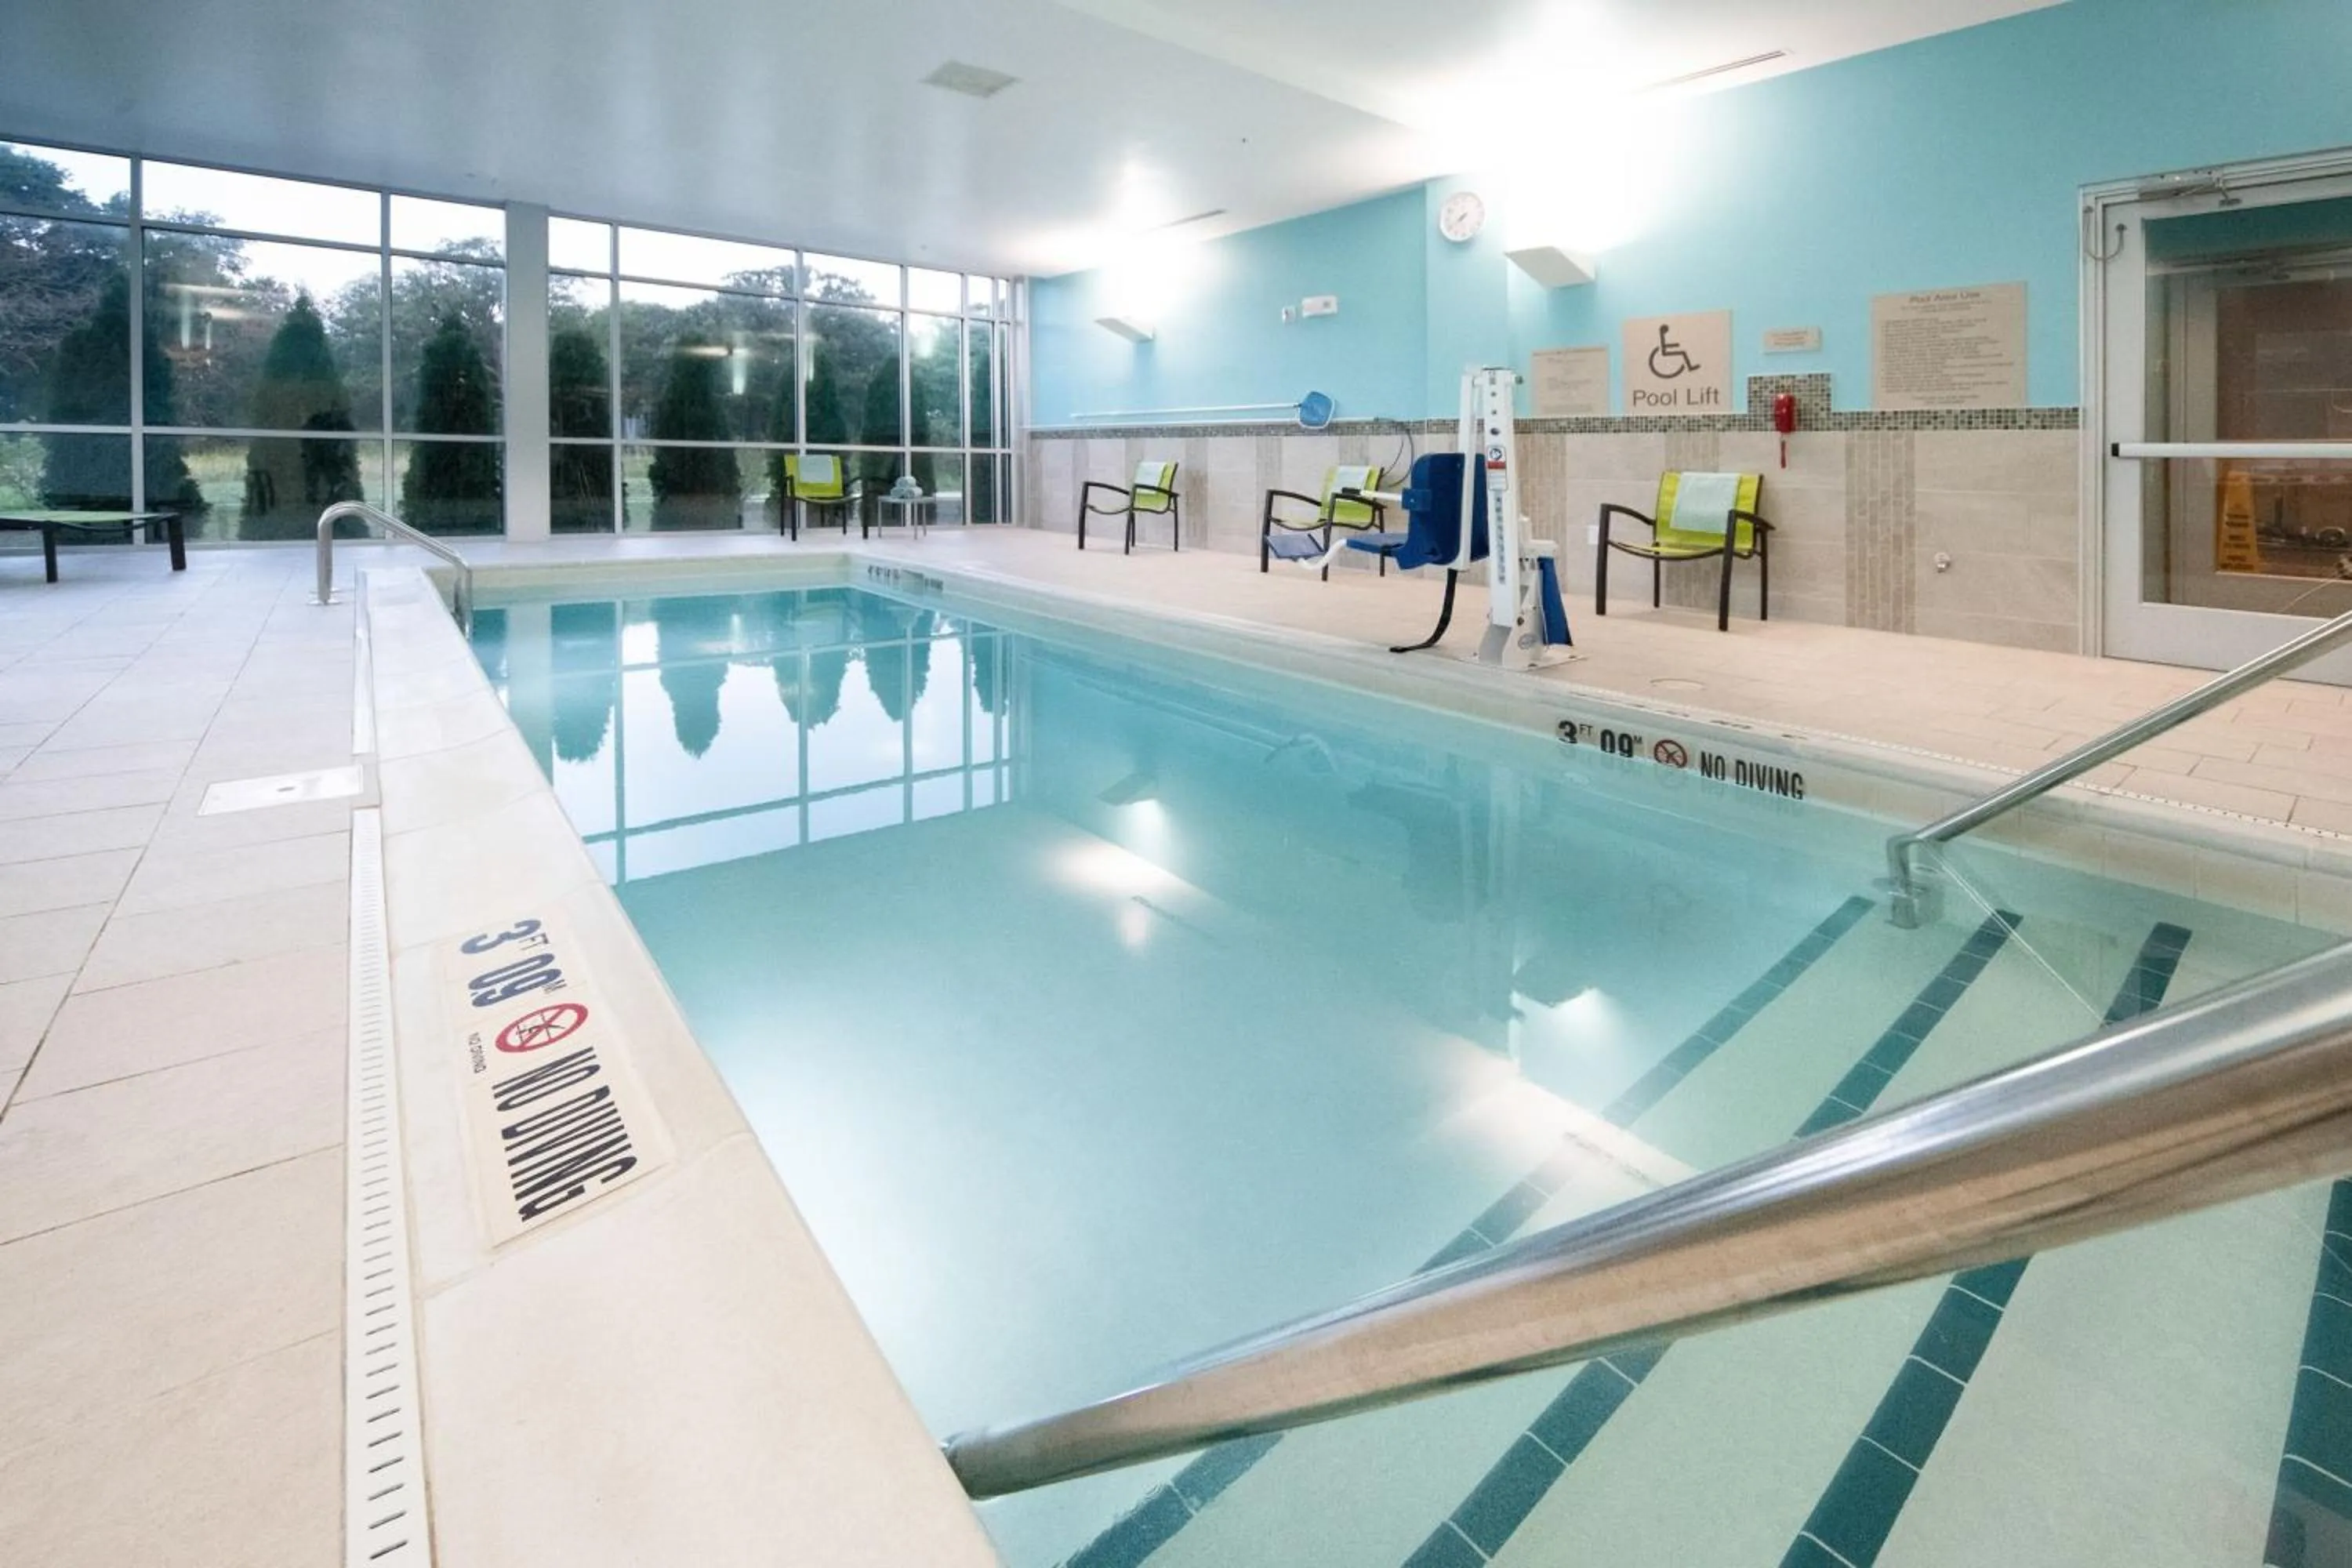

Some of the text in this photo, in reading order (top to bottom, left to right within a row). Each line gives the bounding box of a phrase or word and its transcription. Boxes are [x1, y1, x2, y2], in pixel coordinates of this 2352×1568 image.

[1633, 387, 1719, 407] Pool Lift
[1700, 750, 1804, 800] NO DIVING
[492, 1046, 637, 1222] NO DIVING
